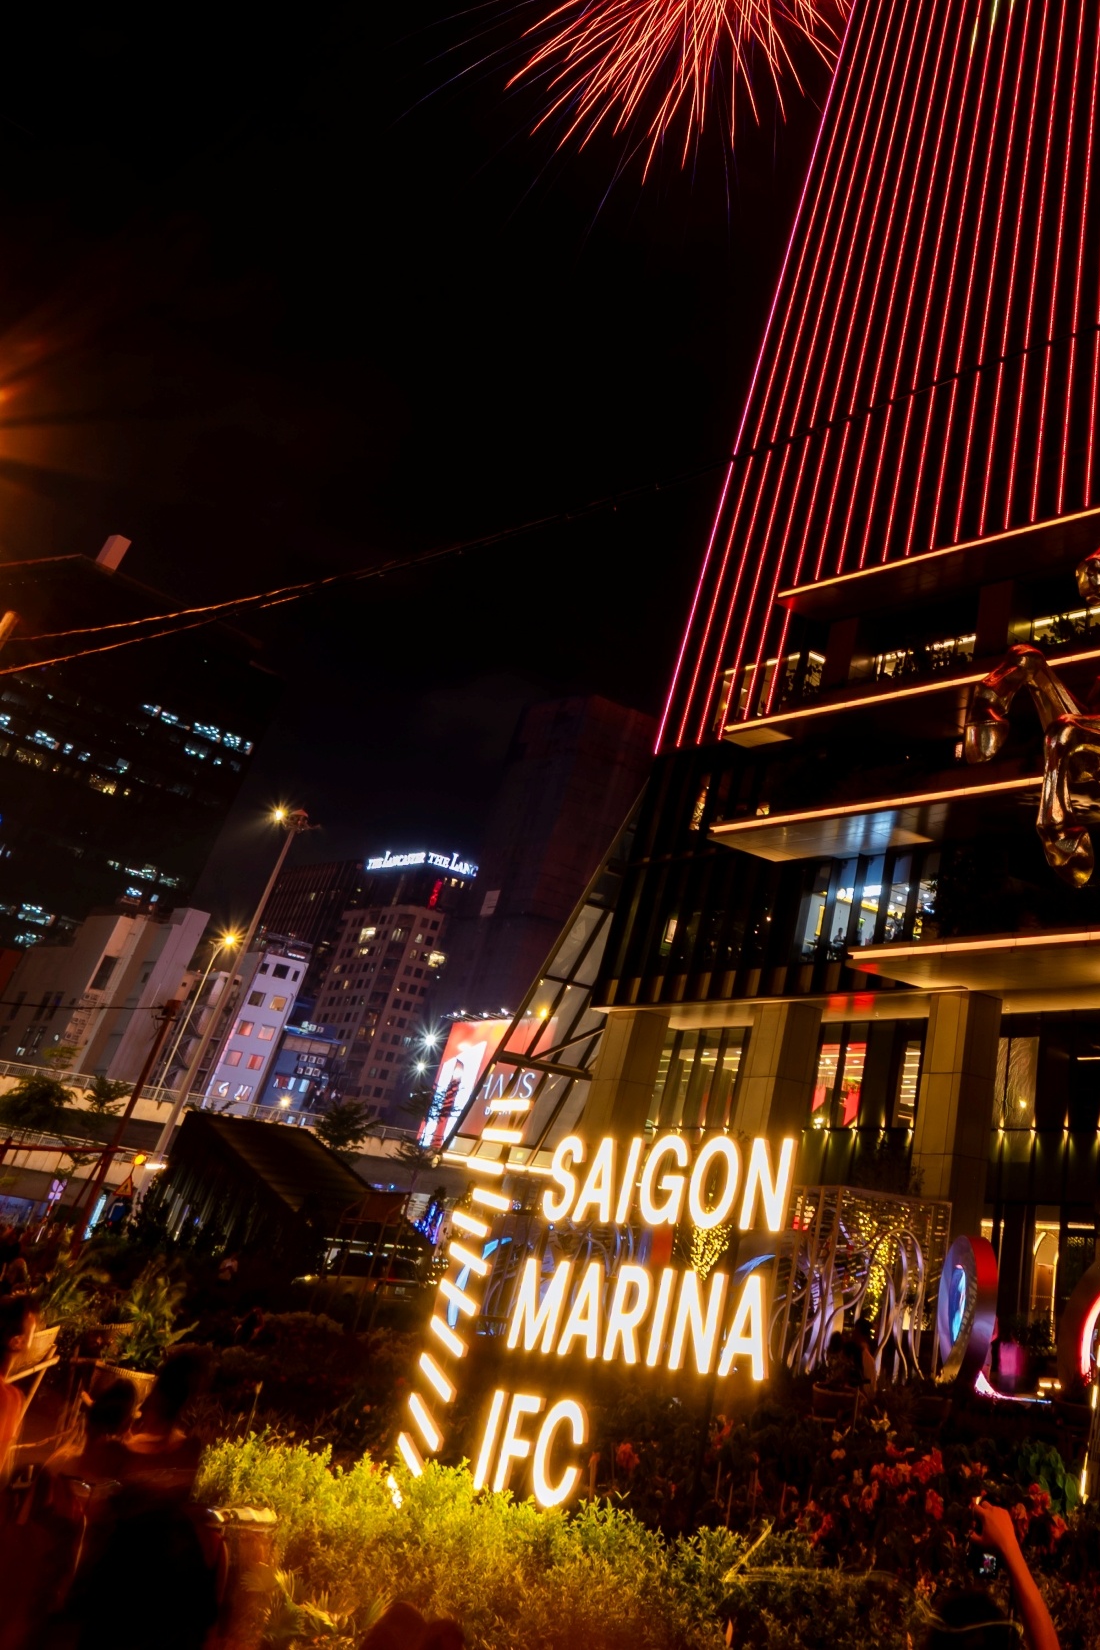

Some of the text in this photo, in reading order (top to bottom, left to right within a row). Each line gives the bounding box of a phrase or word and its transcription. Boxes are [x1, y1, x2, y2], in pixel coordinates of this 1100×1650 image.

[428, 852, 450, 868] THE
[541, 1134, 797, 1232] SAIGON
[506, 1257, 769, 1382] MARINA
[473, 1389, 589, 1509] IFC
